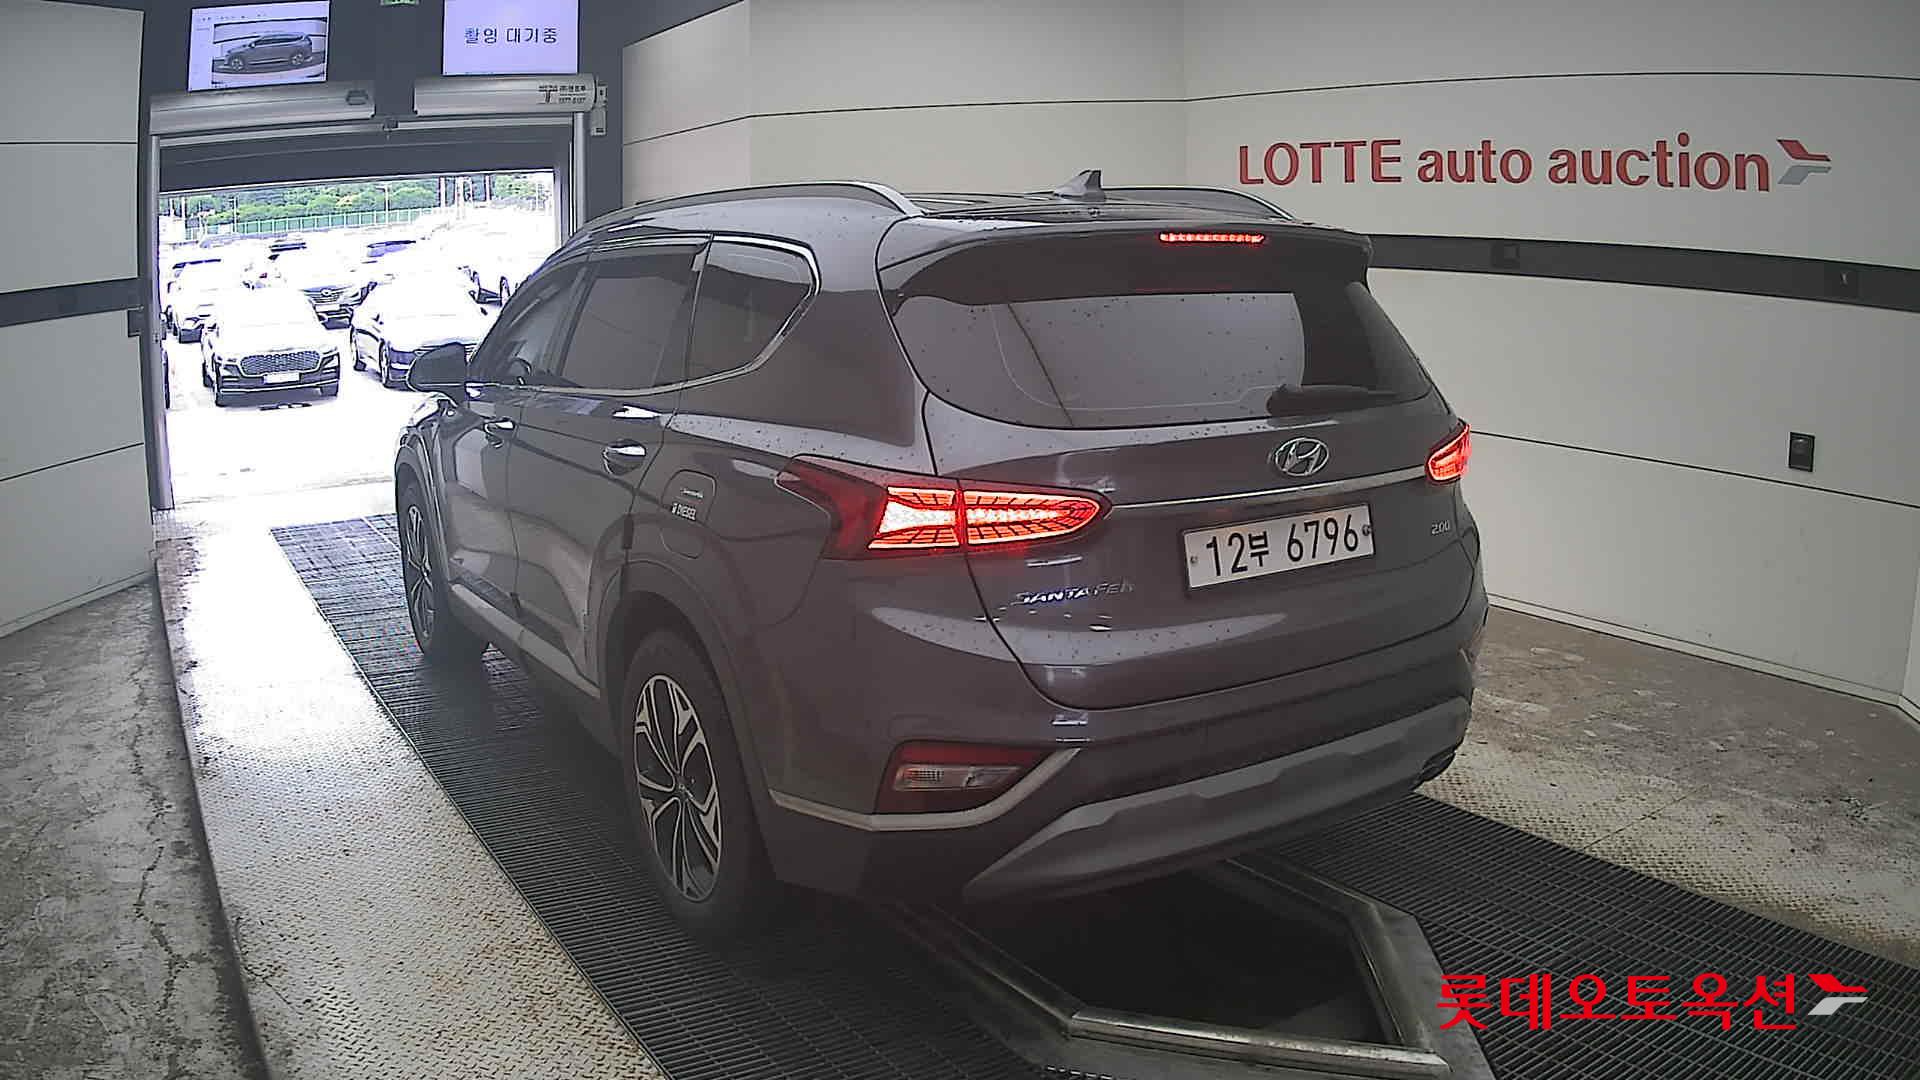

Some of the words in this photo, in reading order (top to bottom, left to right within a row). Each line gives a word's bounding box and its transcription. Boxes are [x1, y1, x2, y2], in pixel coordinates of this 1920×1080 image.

[506, 27, 557, 44] 대기중
[1238, 138, 1401, 186] LOTTE
[1417, 138, 1533, 185] auto
[1548, 132, 1771, 192] auction
[1205, 530, 1270, 577] 12부
[1286, 514, 1360, 563] 6796
